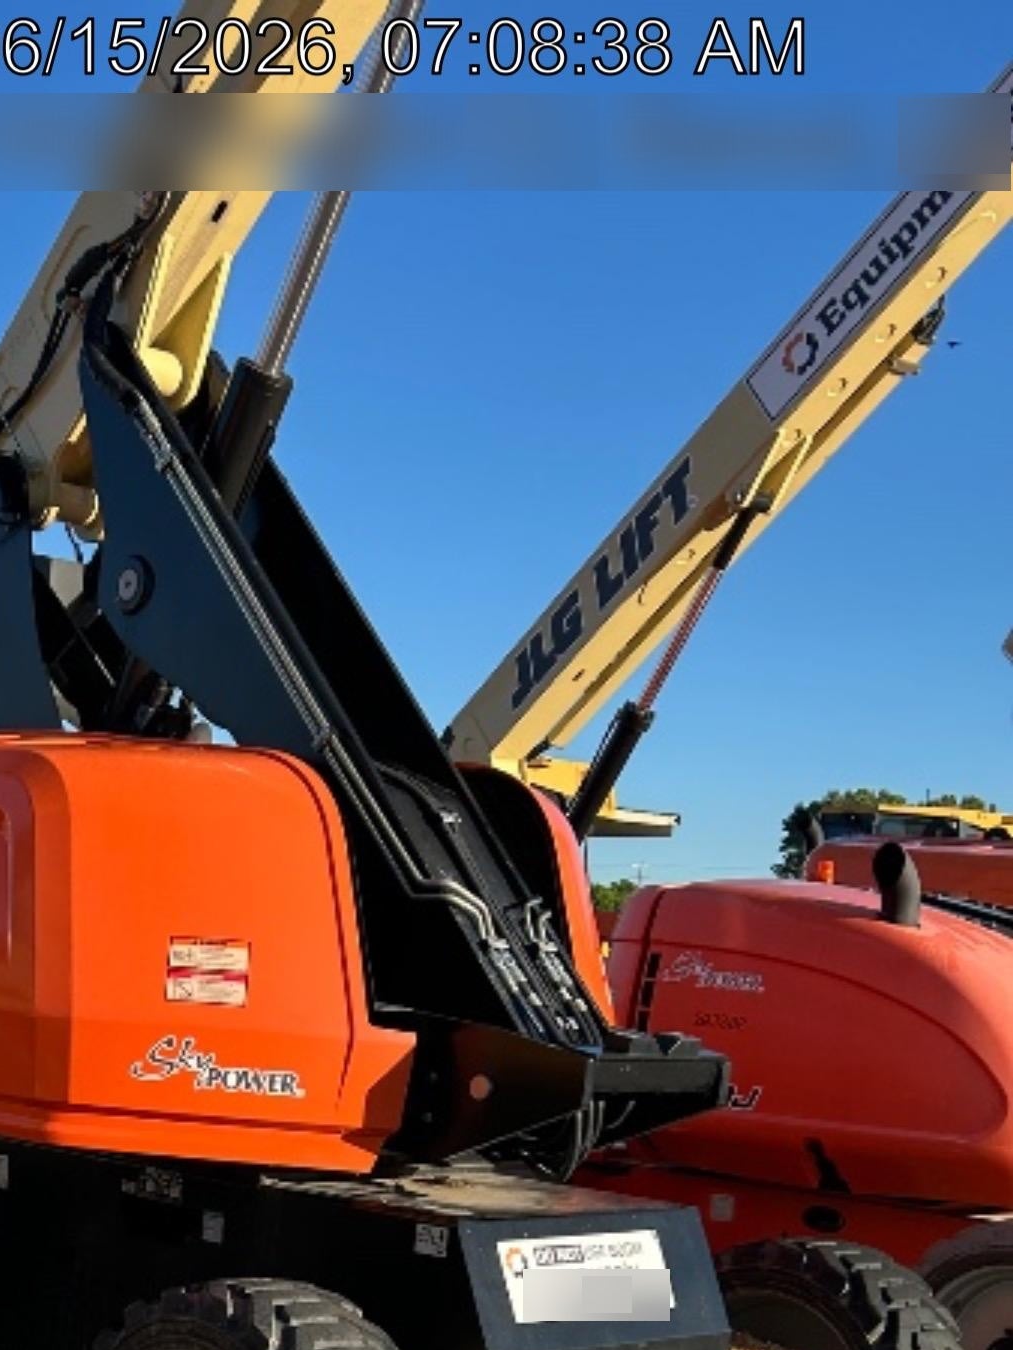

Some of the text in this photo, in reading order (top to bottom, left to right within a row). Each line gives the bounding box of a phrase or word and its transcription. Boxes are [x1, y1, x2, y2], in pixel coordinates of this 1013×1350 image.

[815, 190, 954, 337] Equipm
[511, 455, 691, 709] JLG LIFT
